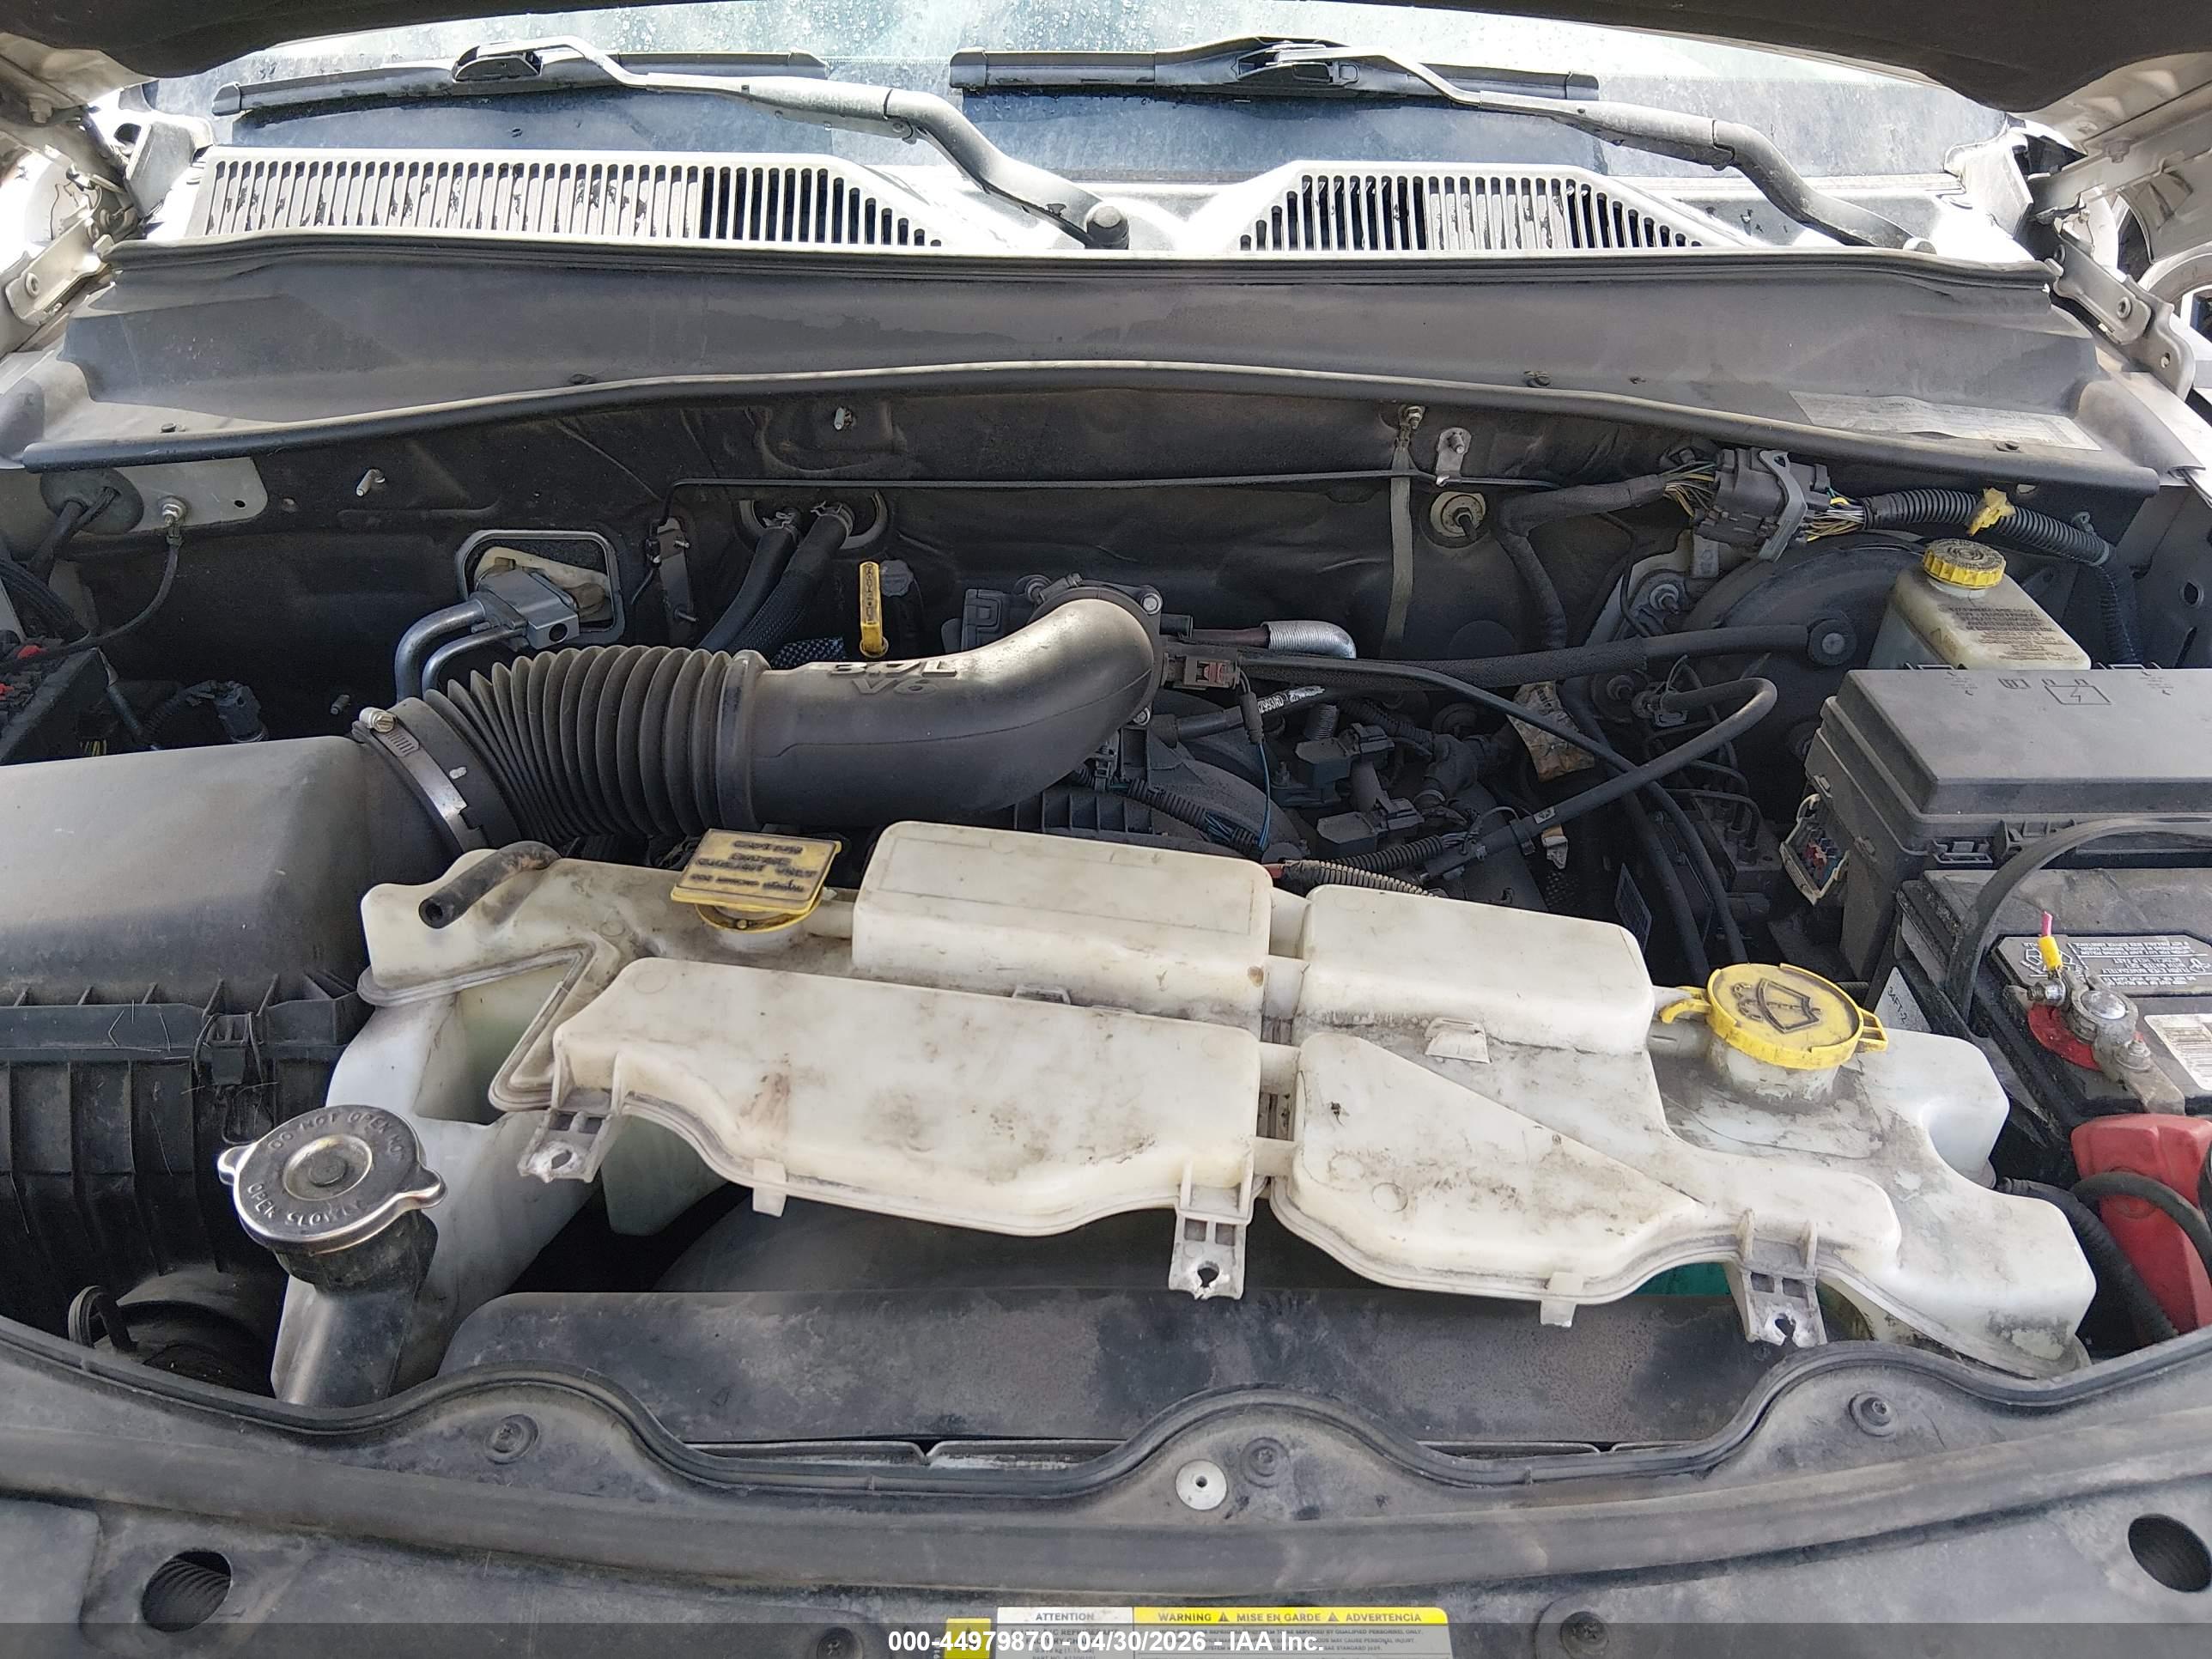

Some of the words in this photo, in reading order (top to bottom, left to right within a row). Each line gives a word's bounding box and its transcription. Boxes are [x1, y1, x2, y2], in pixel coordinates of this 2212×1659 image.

[831, 660, 957, 678] 3.7L
[852, 675, 939, 695] V6
[267, 1130, 295, 1150] DO
[299, 1111, 340, 1133] NOT
[348, 1111, 392, 1135] OPEN
[246, 1182, 276, 1219] OPEN
[1036, 1612, 1095, 1622] ATTENTION
[1158, 1612, 1212, 1622] WARNING
[1236, 1612, 1265, 1622] MISE
[1267, 1612, 1281, 1622] EN
[1283, 1612, 1322, 1622] GARDE
[1345, 1612, 1422, 1622] ADVERTENCIA
